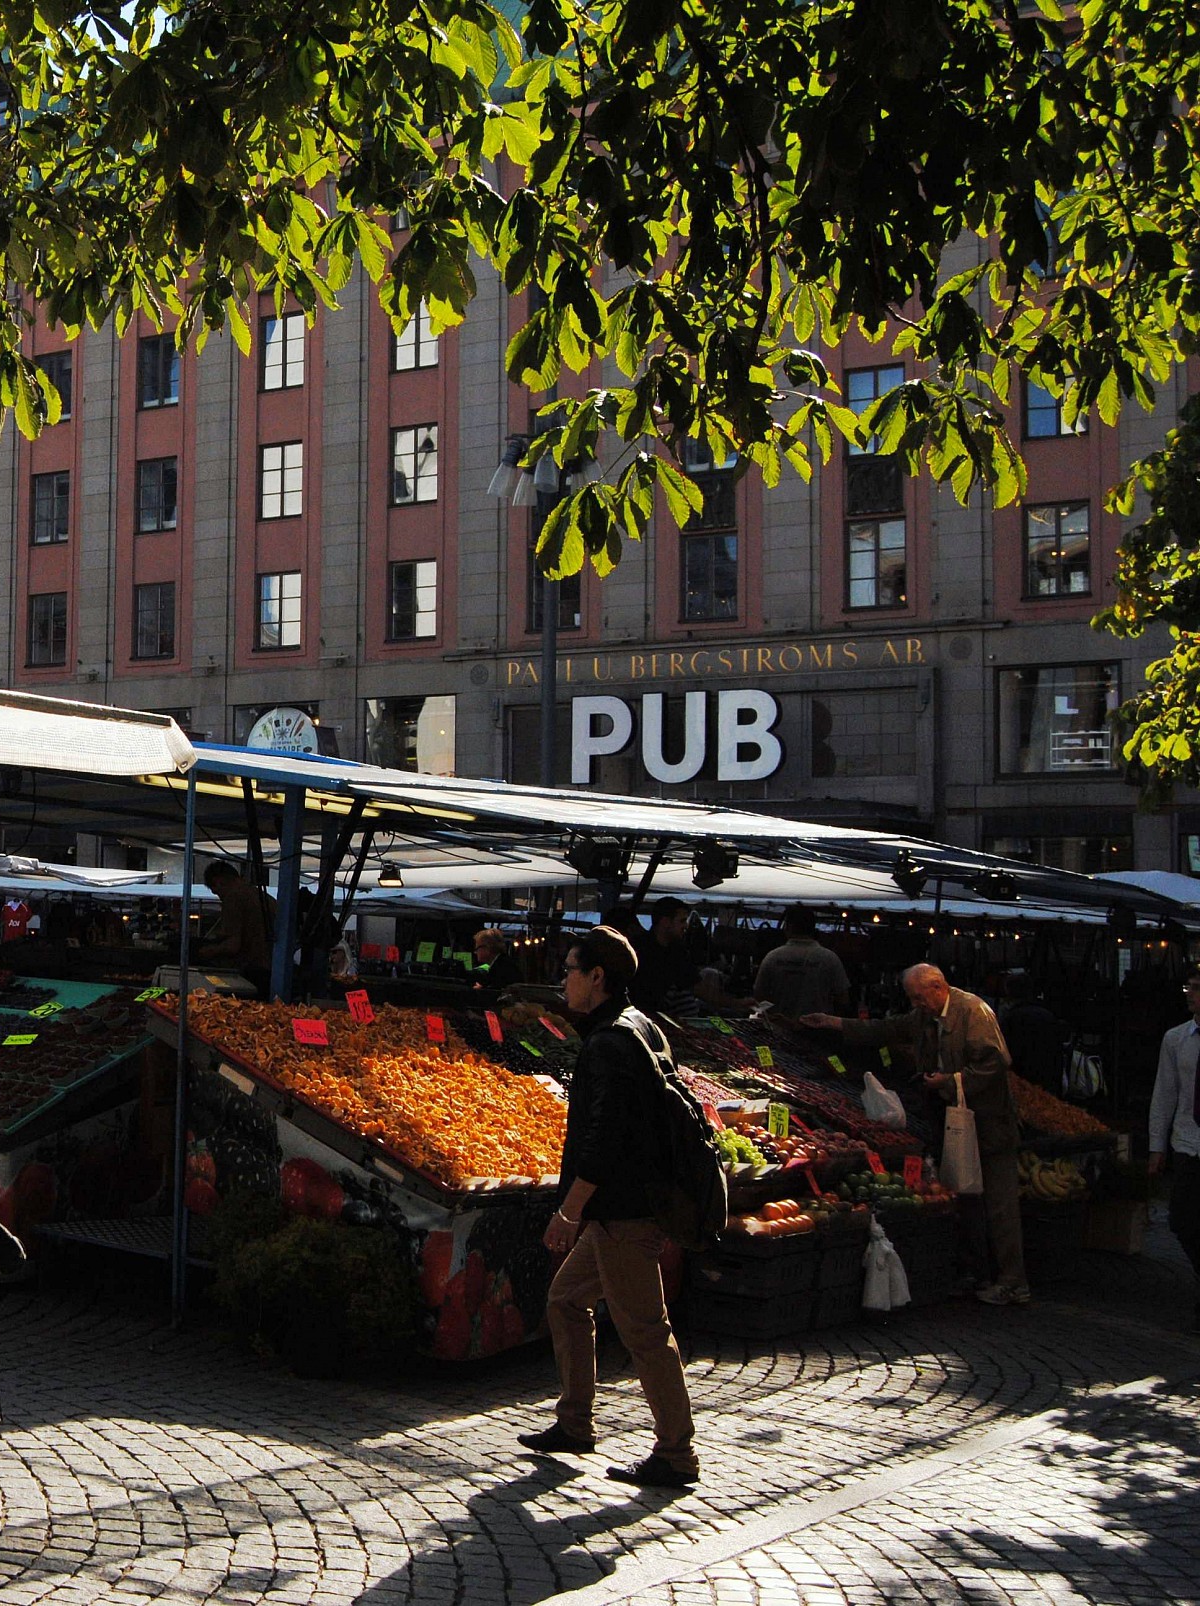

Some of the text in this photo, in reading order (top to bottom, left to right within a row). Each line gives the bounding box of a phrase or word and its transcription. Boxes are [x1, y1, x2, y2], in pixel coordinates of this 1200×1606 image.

[507, 658, 577, 686] PAL
[630, 642, 859, 680] BERGSTRÖMS
[878, 638, 927, 666] A.B.
[571, 688, 786, 785] PUB
